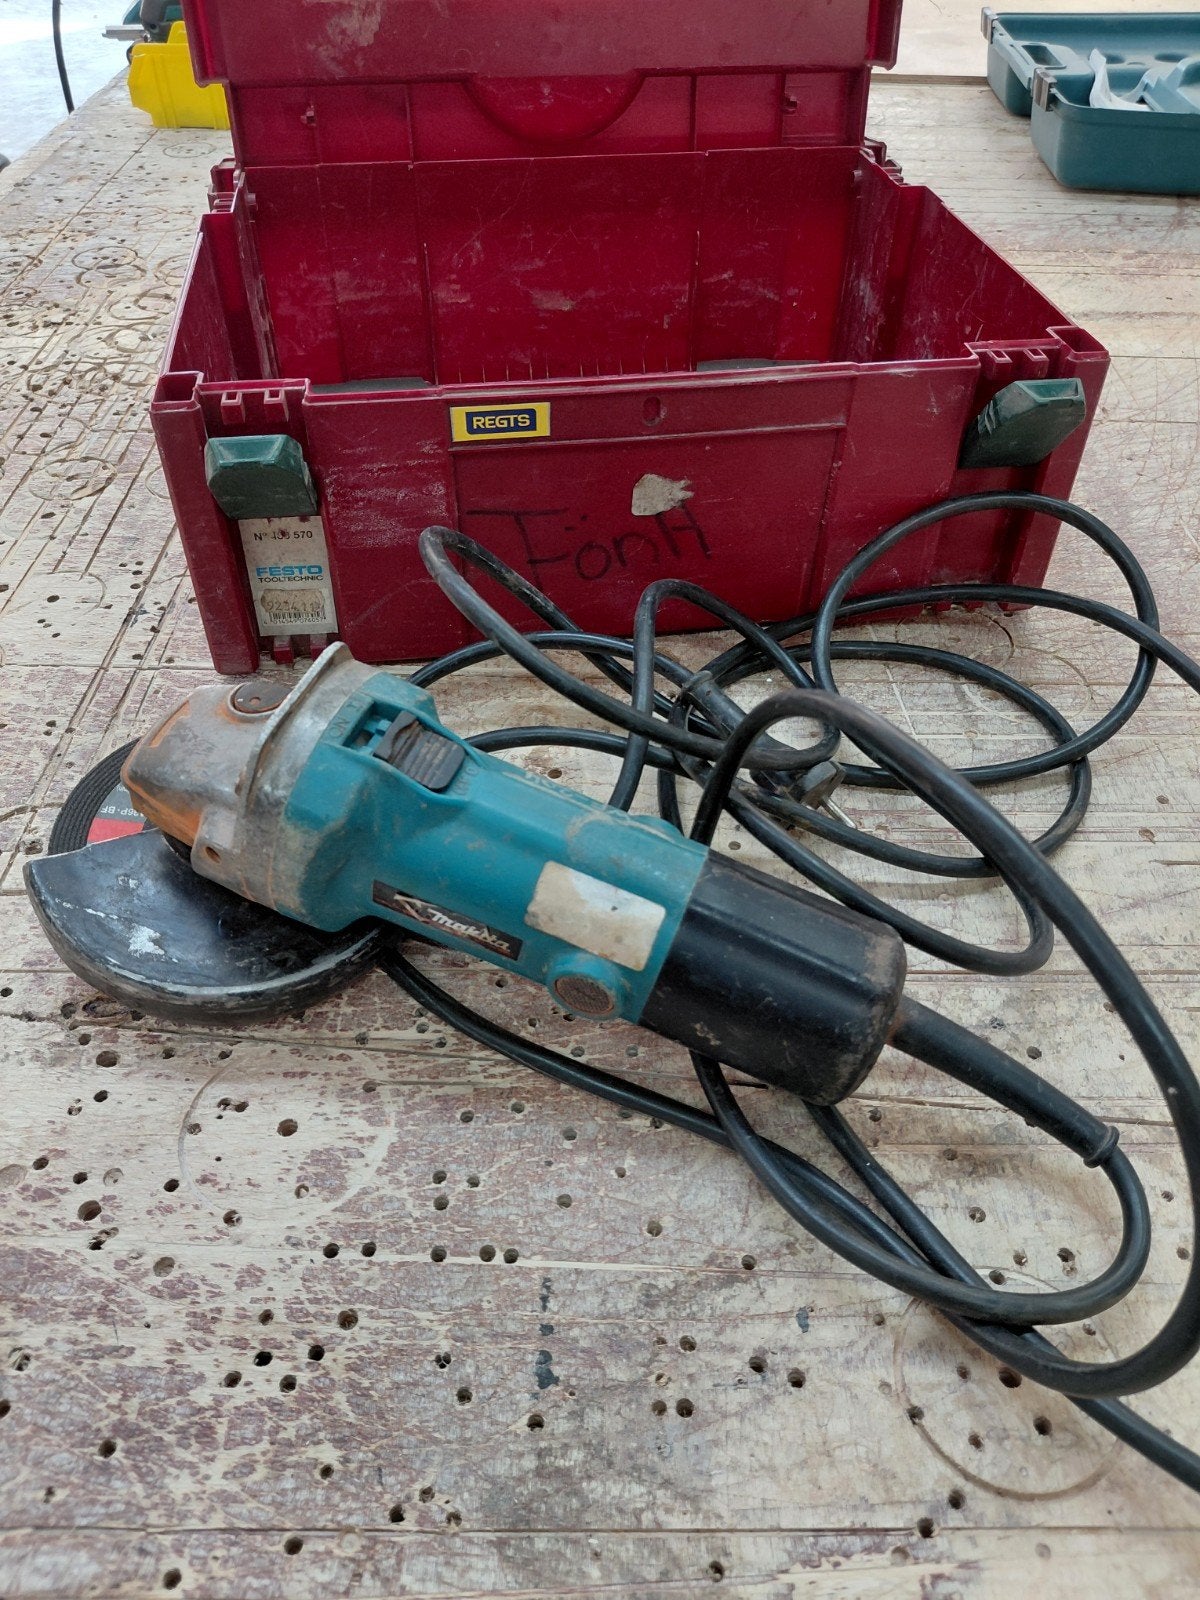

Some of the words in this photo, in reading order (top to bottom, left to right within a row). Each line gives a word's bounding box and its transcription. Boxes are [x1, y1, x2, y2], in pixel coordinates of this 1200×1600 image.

[472, 413, 531, 430] REGTS
[293, 530, 313, 540] 570
[255, 565, 323, 577] FESTO
[257, 575, 324, 584] TOOLTECHNIC
